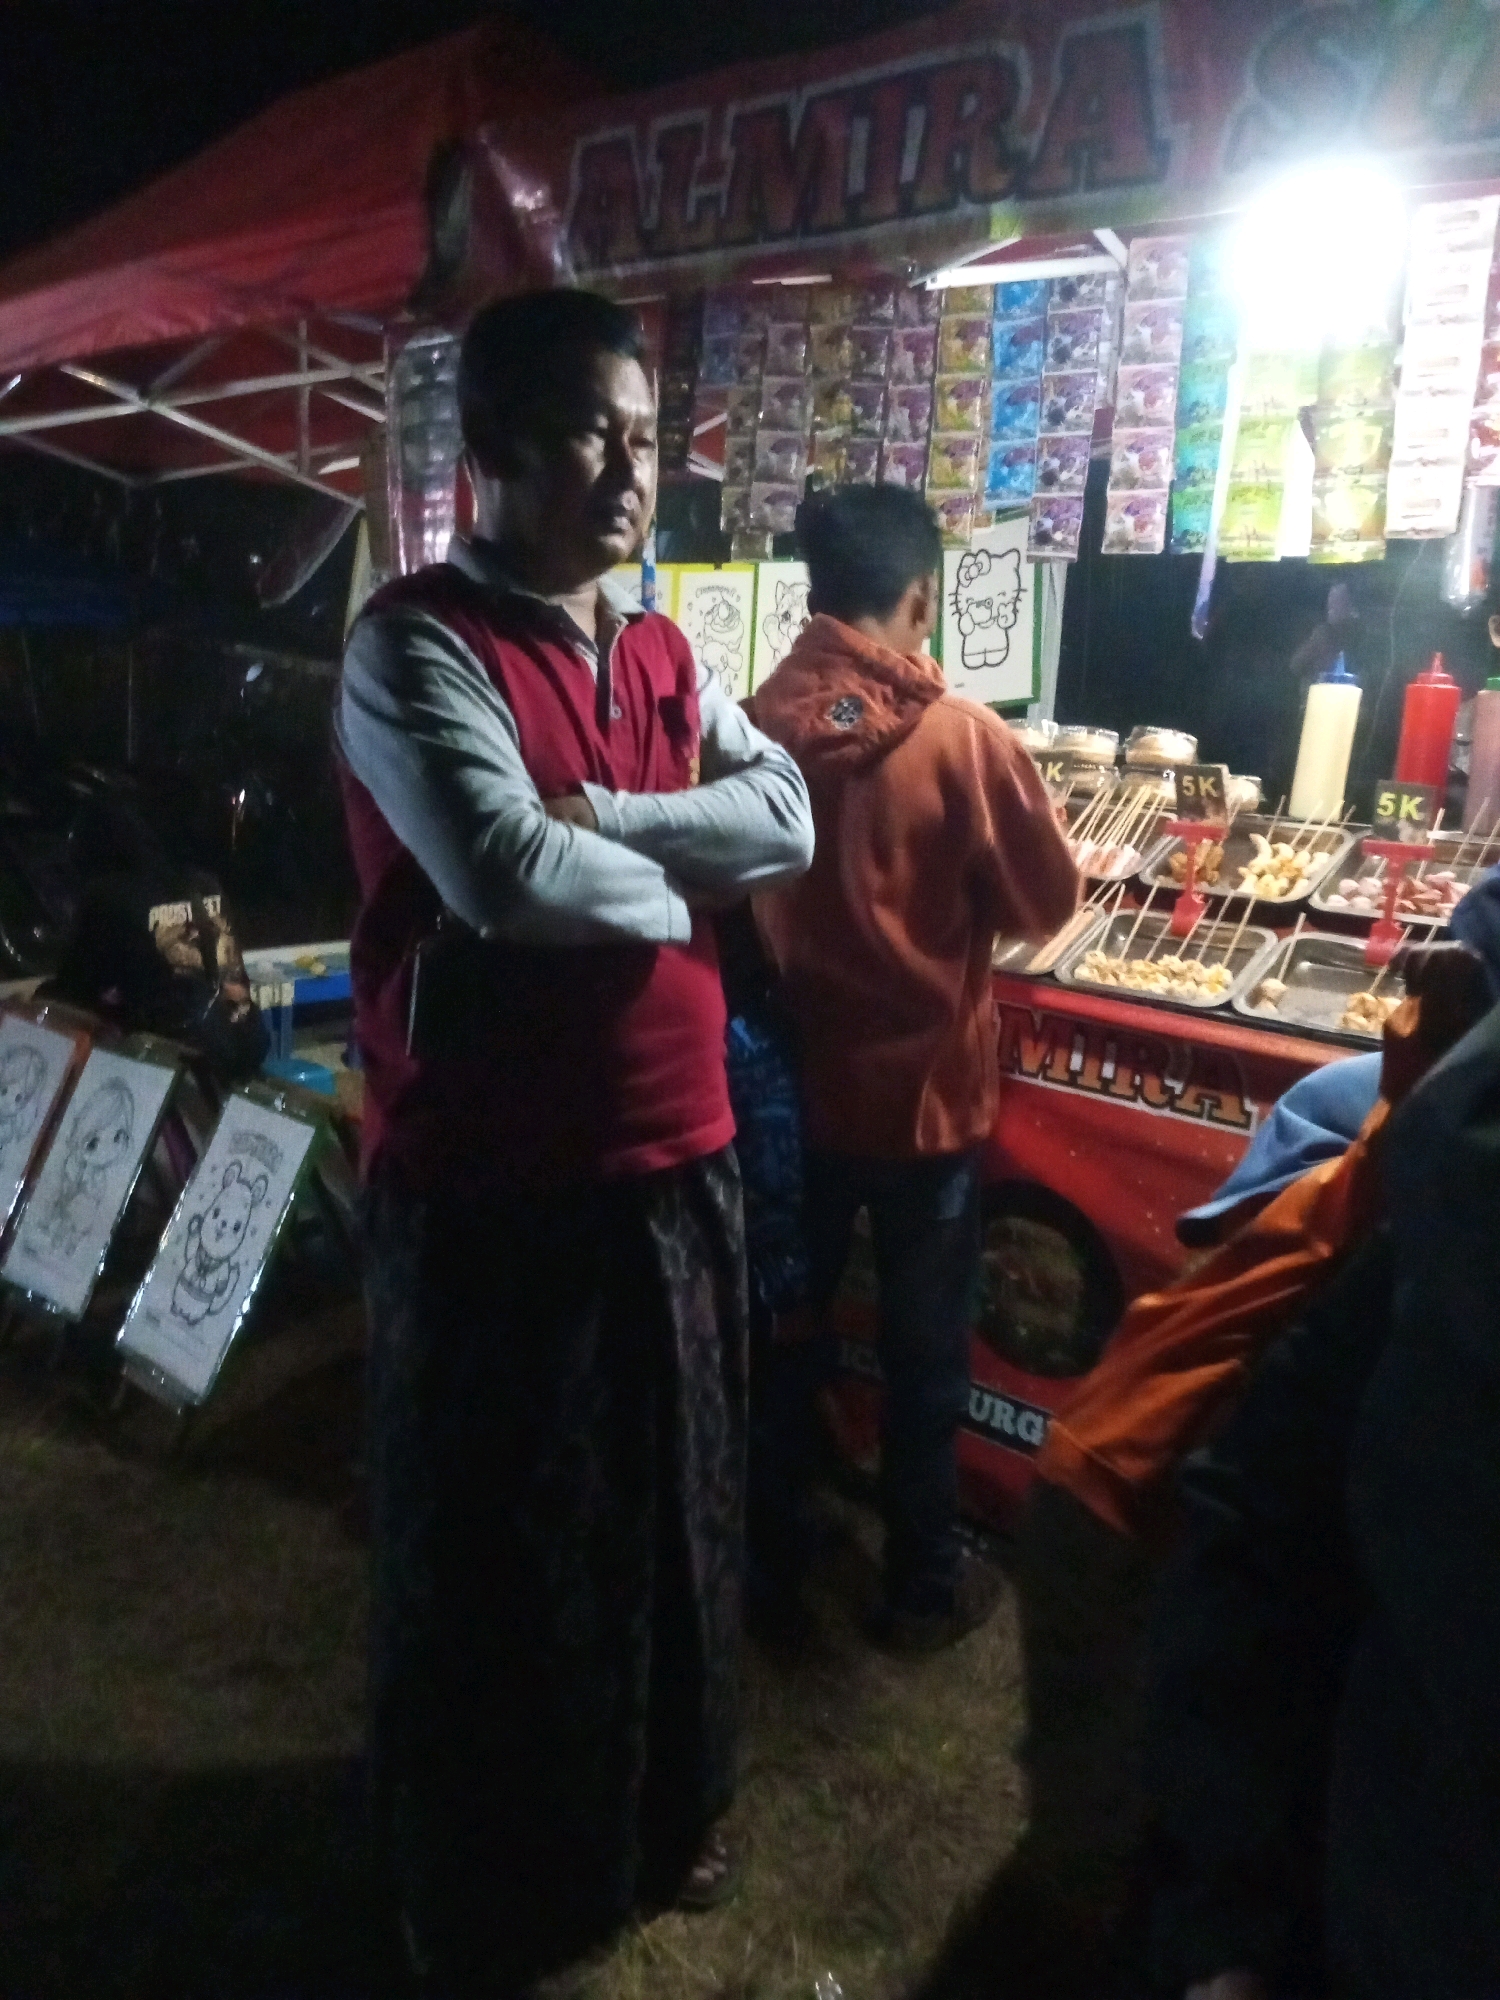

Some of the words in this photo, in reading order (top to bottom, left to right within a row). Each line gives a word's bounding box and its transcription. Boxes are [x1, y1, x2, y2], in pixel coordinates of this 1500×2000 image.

[565, 14, 1172, 276] ALMIRA
[1181, 775, 1218, 798] 5K
[1376, 791, 1425, 821] 5K
